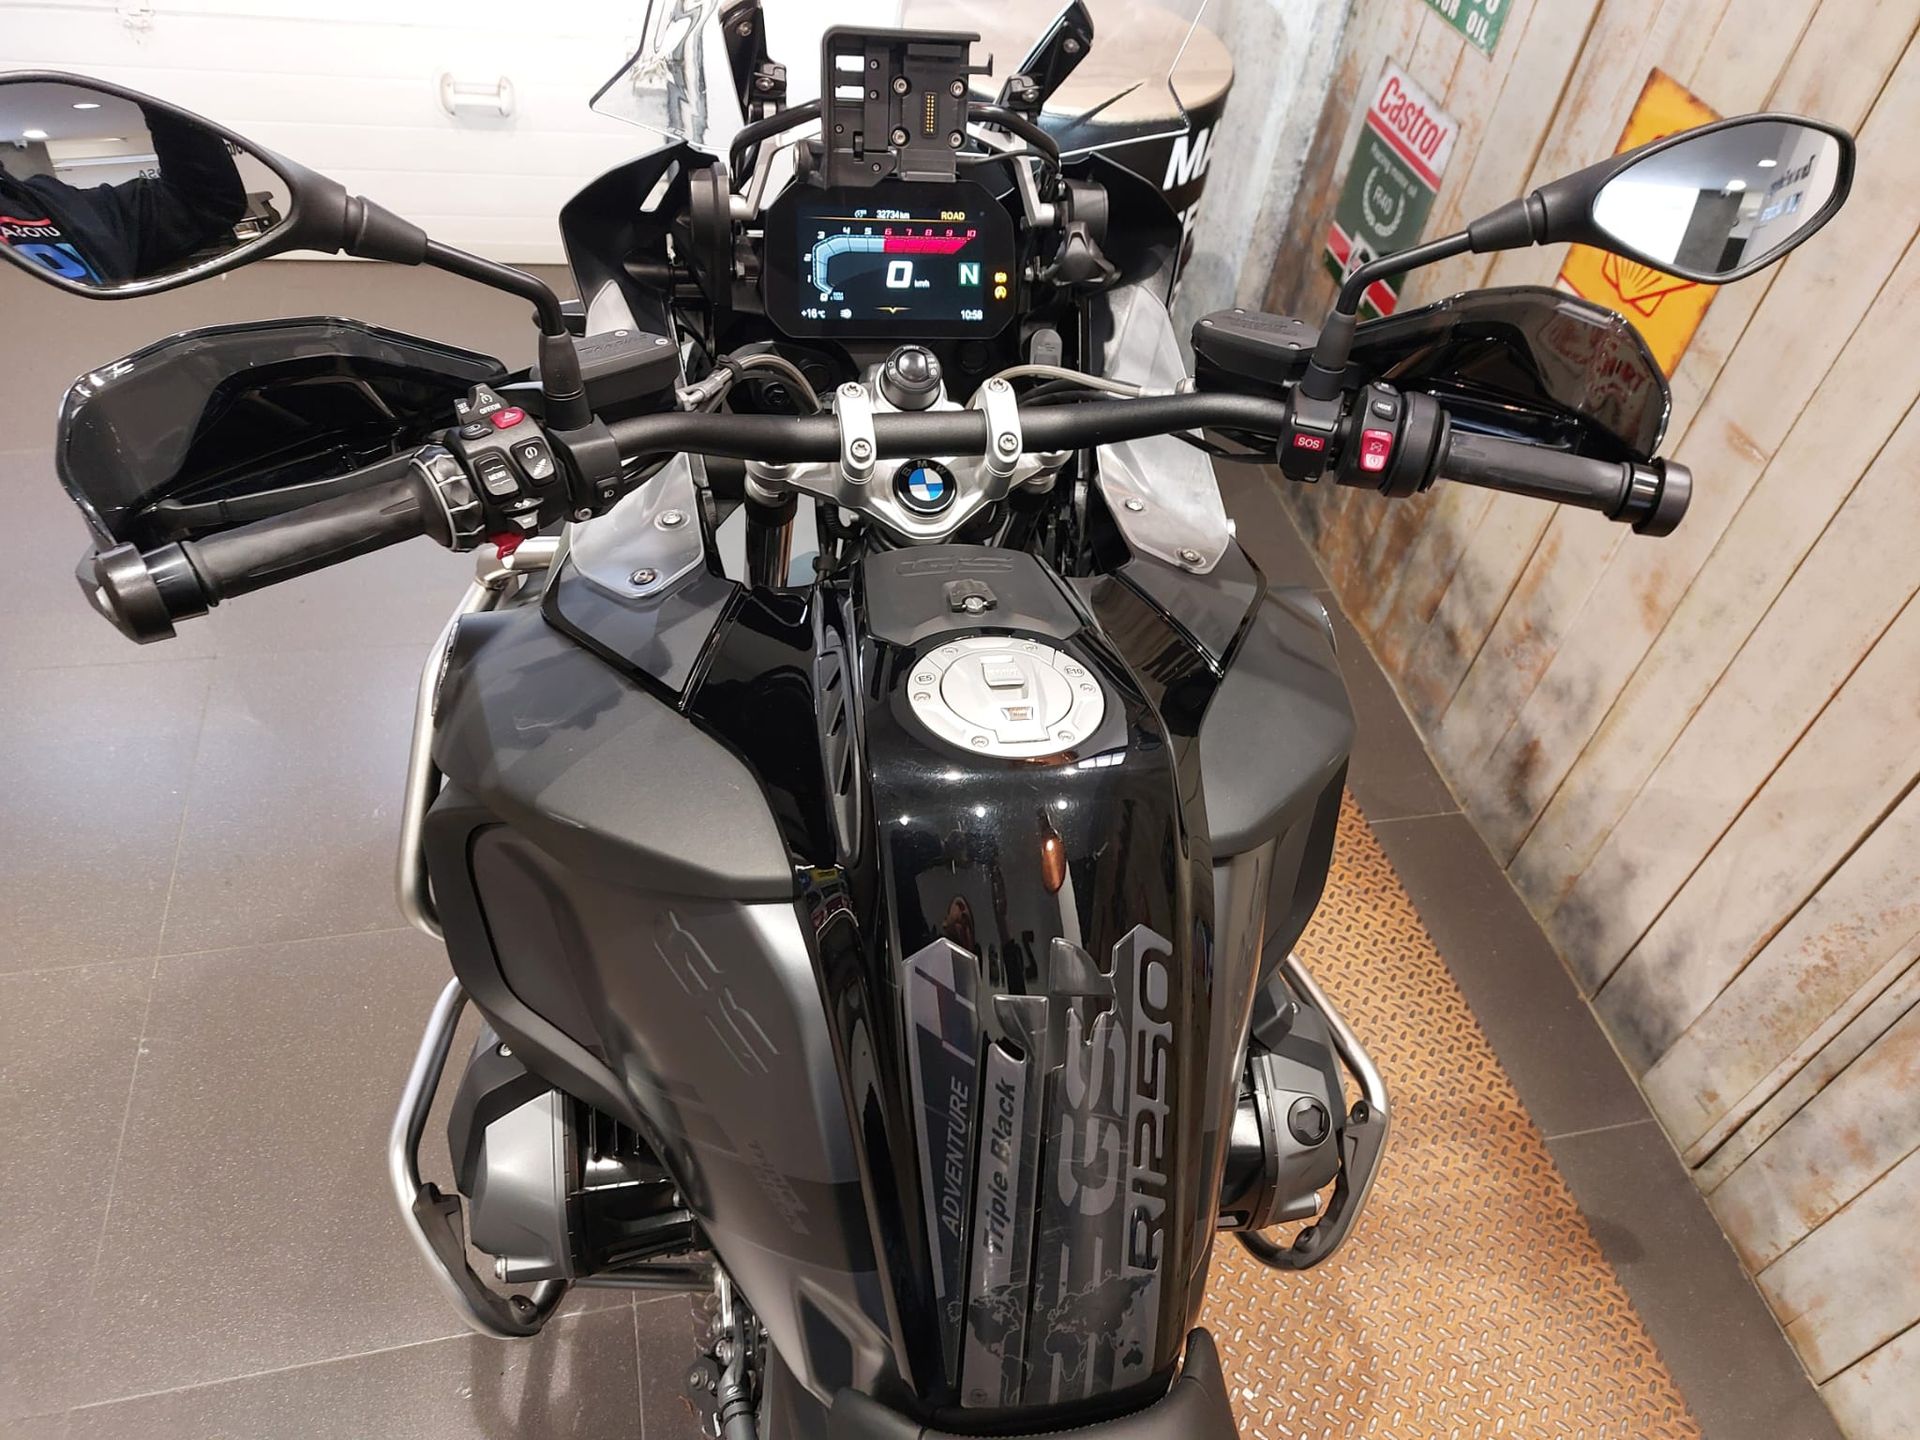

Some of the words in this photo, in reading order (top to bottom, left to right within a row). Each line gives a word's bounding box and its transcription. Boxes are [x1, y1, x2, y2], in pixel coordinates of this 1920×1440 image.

[1466, 10, 1489, 44] OIL
[1379, 77, 1447, 160] Castrol
[1373, 184, 1393, 215] R40
[941, 211, 965, 220] ROAD
[817, 231, 826, 239] 3
[843, 227, 851, 235] 4
[864, 227, 872, 235] 5
[884, 228, 893, 236] 6
[906, 228, 913, 236] 7
[946, 229, 953, 237] 9
[967, 230, 976, 238] 10
[804, 253, 812, 261] 2
[886, 260, 913, 288] 0
[960, 265, 979, 284] N
[820, 293, 829, 302] 0
[960, 309, 983, 320] 10:58
[1298, 437, 1320, 449] SOS
[901, 460, 946, 477] BMW
[1066, 667, 1084, 675] E10
[917, 674, 933, 682] E5
[1057, 1007, 1126, 1216] GS
[1127, 946, 1173, 1272] R1250
[989, 1078, 1017, 1167] Black
[940, 1075, 970, 1238] ADVENTURE
[981, 1172, 1013, 1254] Triple
